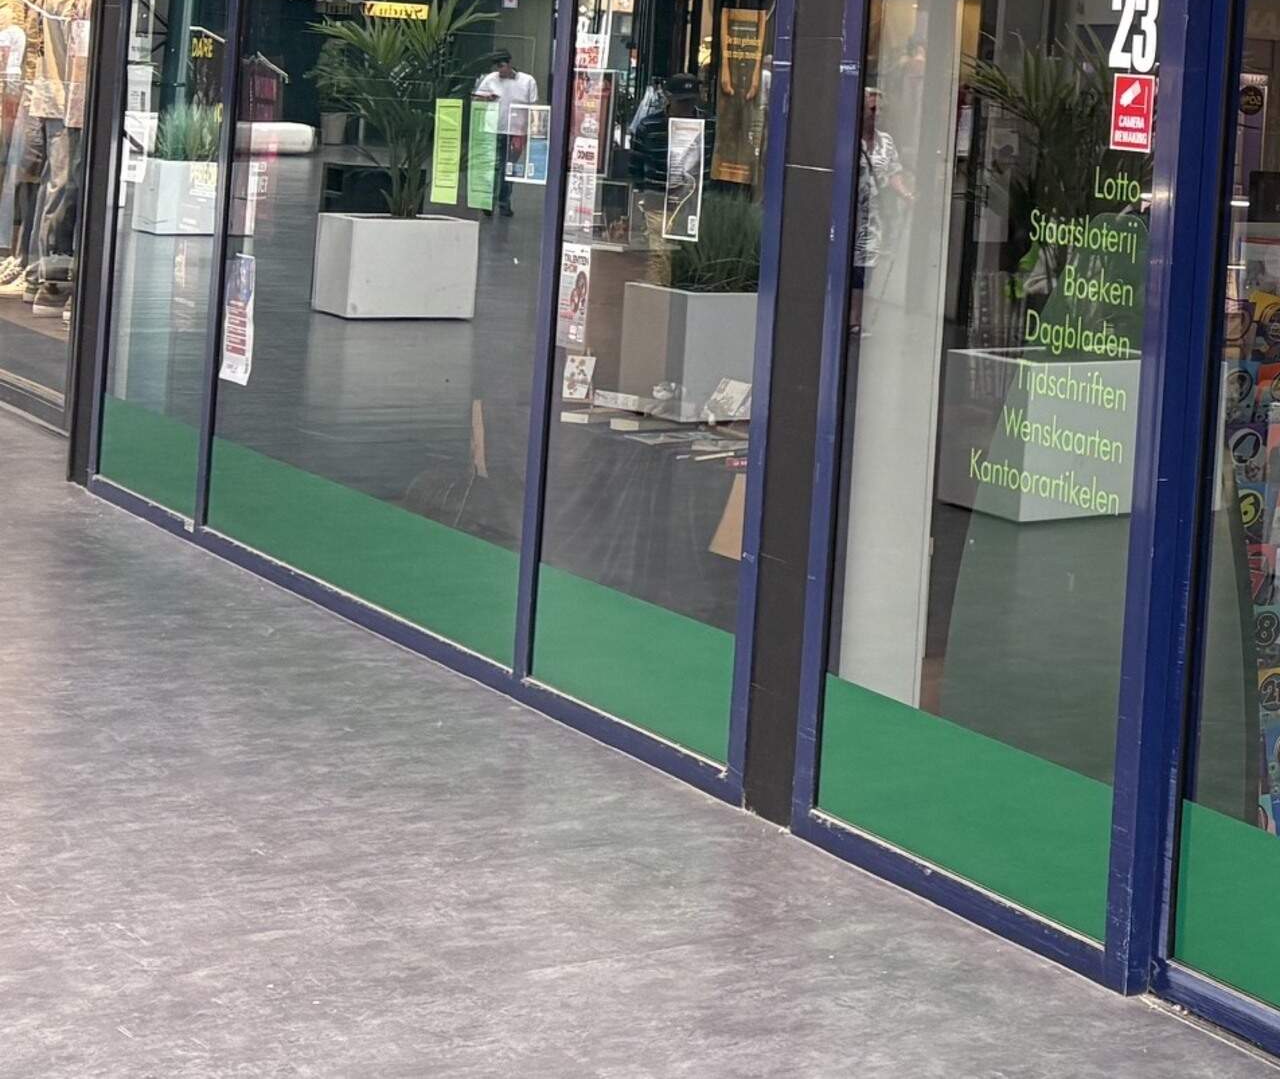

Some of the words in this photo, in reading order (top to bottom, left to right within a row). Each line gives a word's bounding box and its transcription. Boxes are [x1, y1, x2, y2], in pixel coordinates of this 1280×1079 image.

[1095, 167, 1140, 203] Lotto
[1029, 208, 1138, 264] Staatsloterij
[1063, 264, 1133, 307] Boeken
[1025, 310, 1130, 359] Dagbladen
[1017, 358, 1127, 412] Tijdschriften
[1004, 407, 1123, 464] Wenskaarten
[970, 448, 1119, 515] Kantoorartikelen
